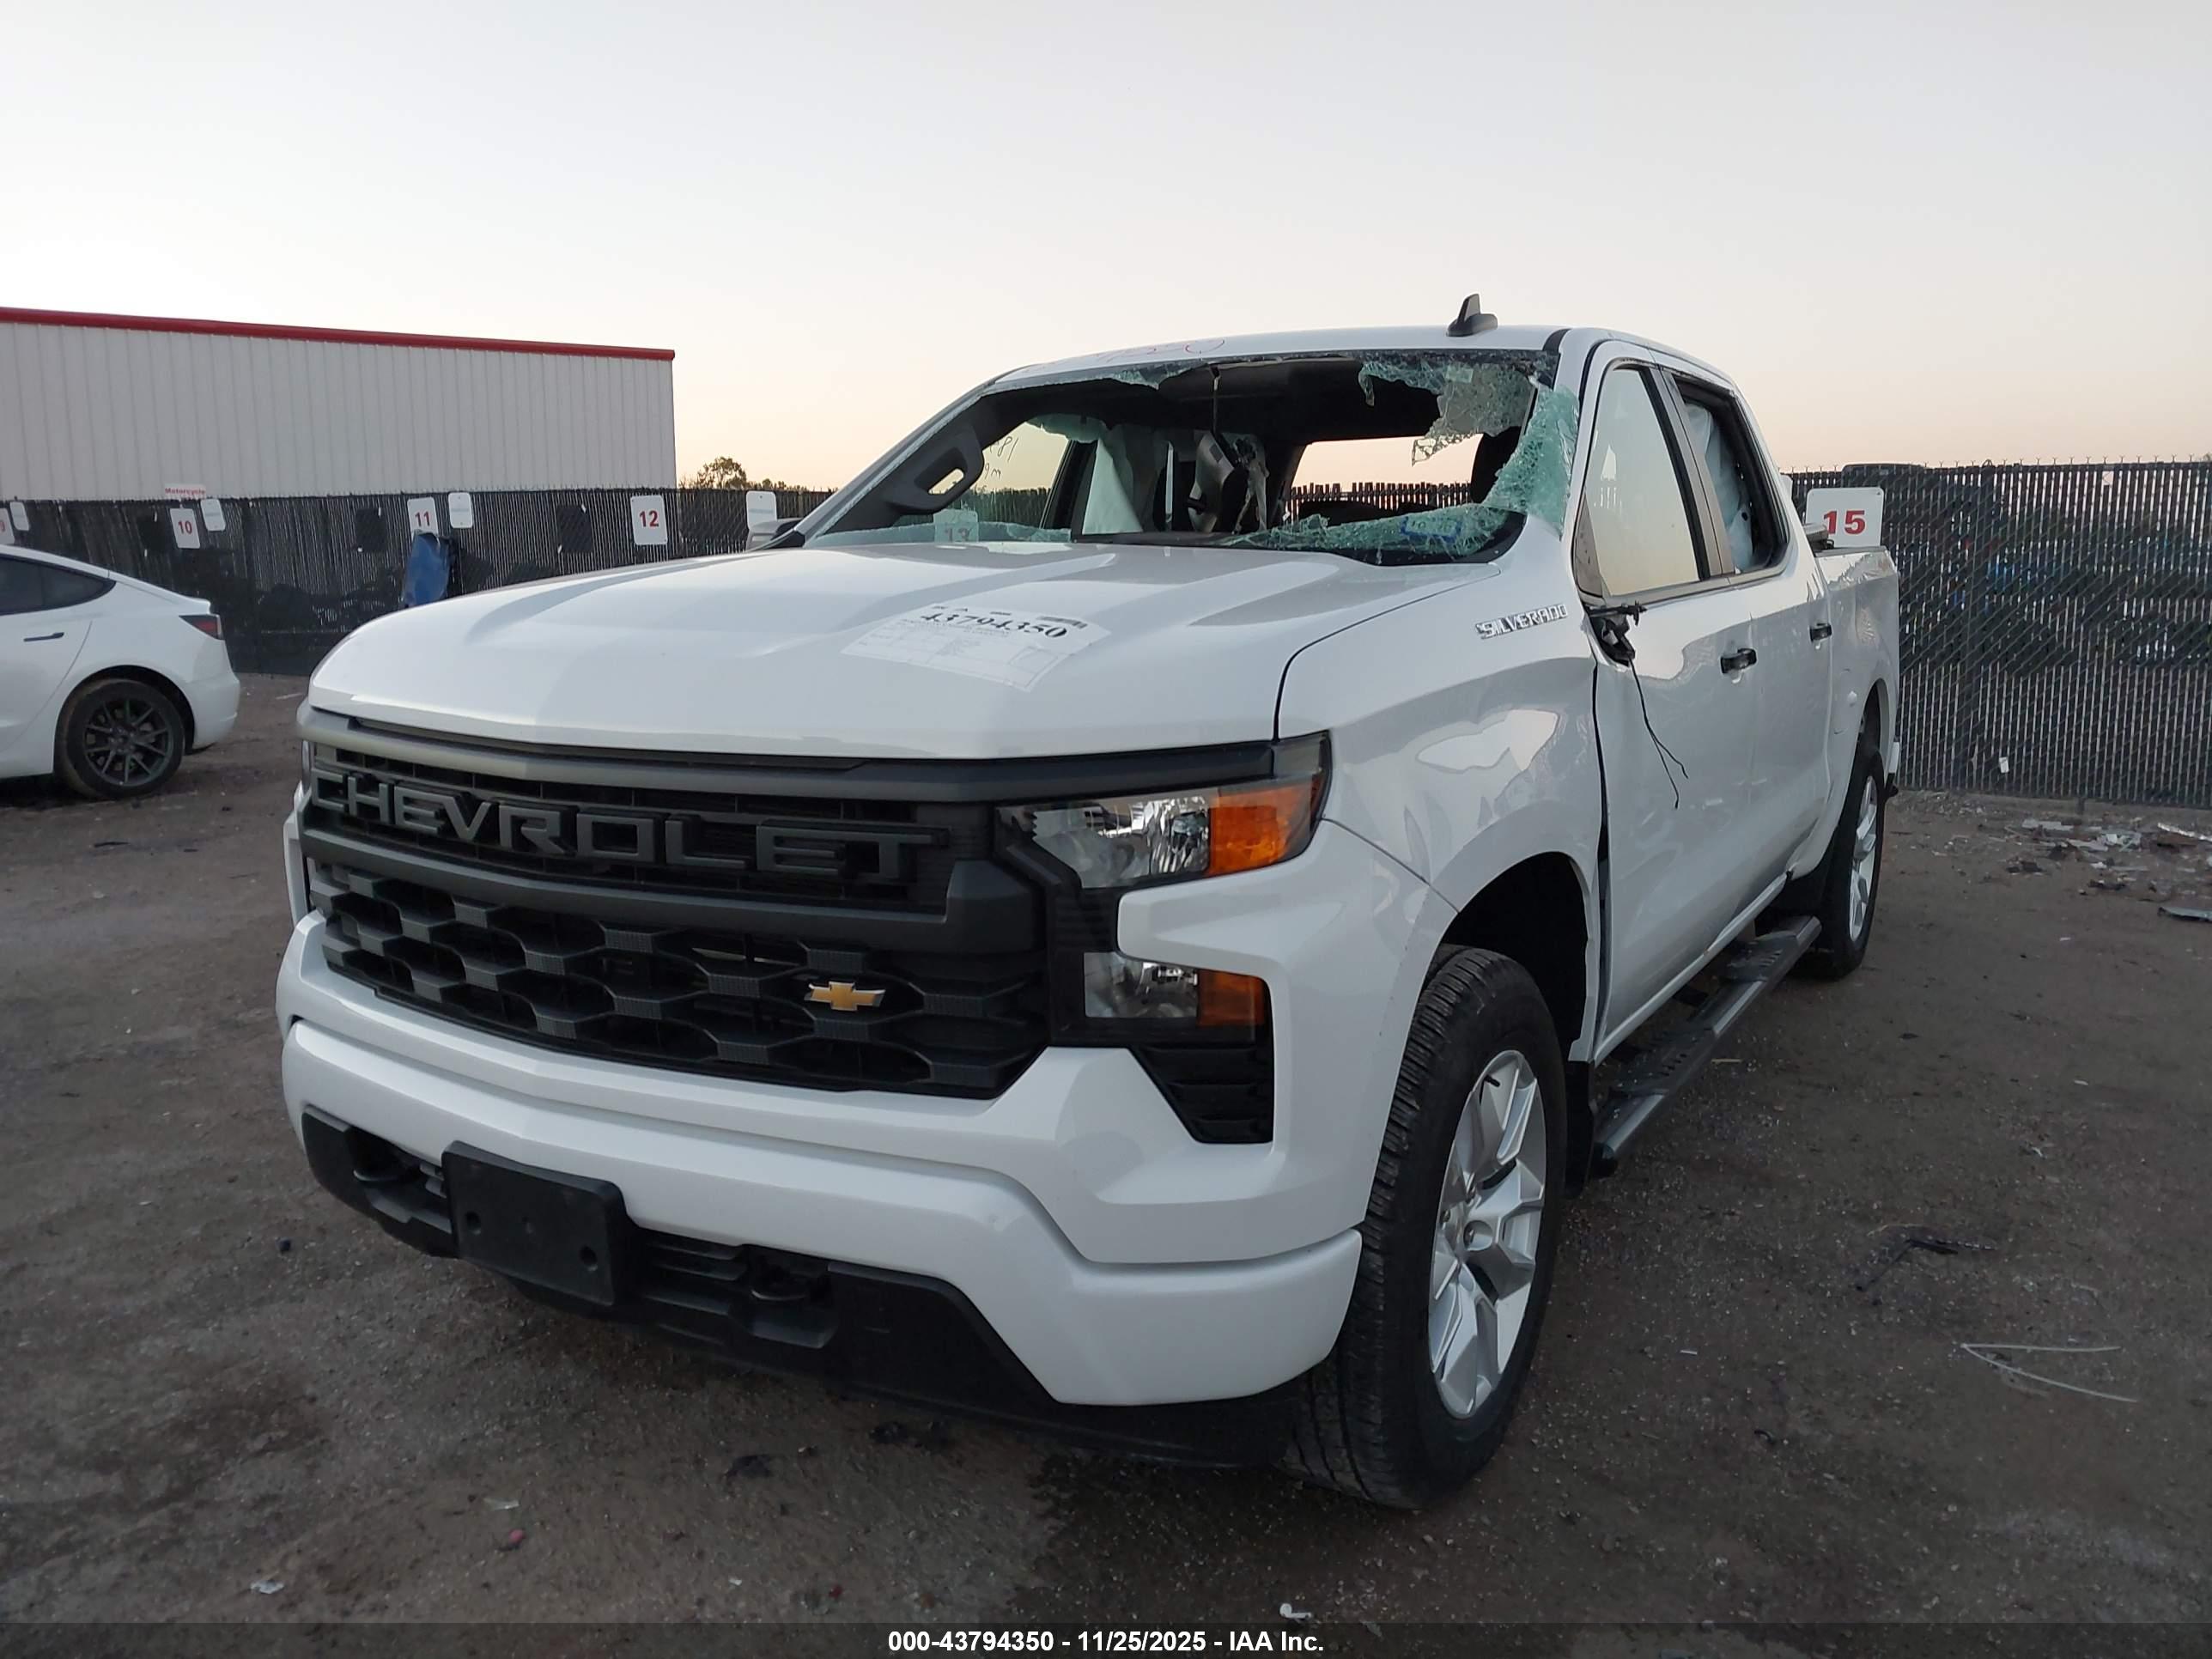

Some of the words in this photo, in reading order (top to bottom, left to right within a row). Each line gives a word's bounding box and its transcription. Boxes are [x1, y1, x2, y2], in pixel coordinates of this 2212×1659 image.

[178, 520, 192, 534] 10
[415, 511, 430, 526] 11
[640, 510, 659, 527] 12
[1823, 510, 1865, 534] 15
[921, 605, 1067, 629] 43794350
[1476, 604, 1568, 639] SILVERADO
[311, 774, 943, 879] CHEVROLET
